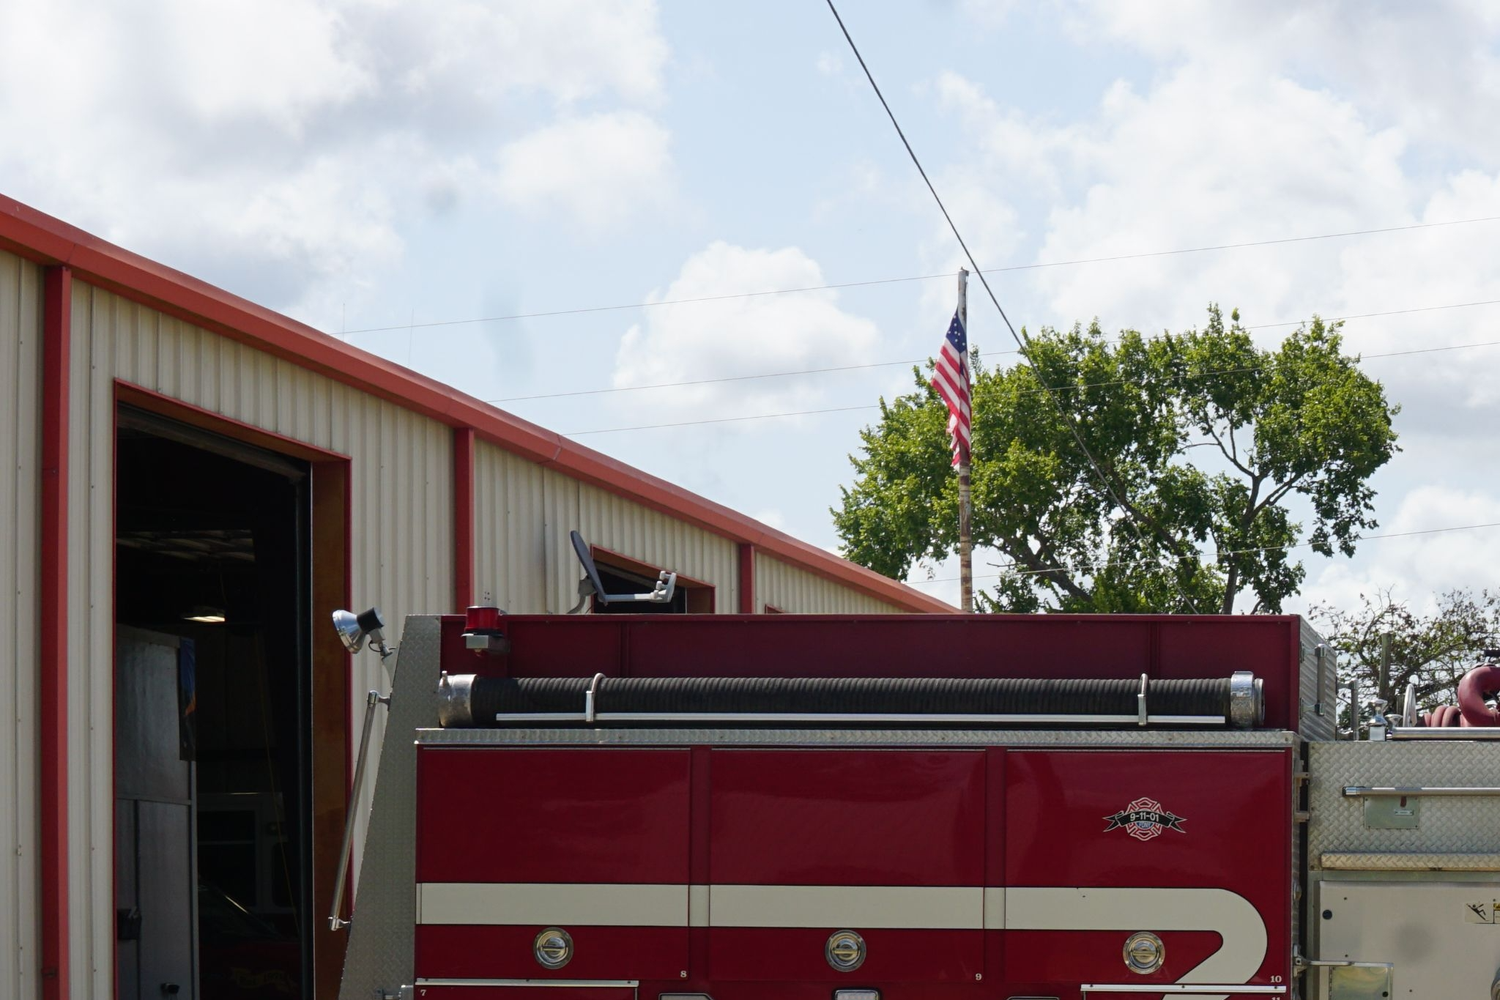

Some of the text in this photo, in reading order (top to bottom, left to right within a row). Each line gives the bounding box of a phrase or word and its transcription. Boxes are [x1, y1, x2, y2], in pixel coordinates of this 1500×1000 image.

[1130, 812, 1160, 822] 9-11-01
[680, 970, 687, 978] 8
[975, 972, 982, 981] 9
[1270, 975, 1282, 983] 10
[420, 989, 427, 997] 7
